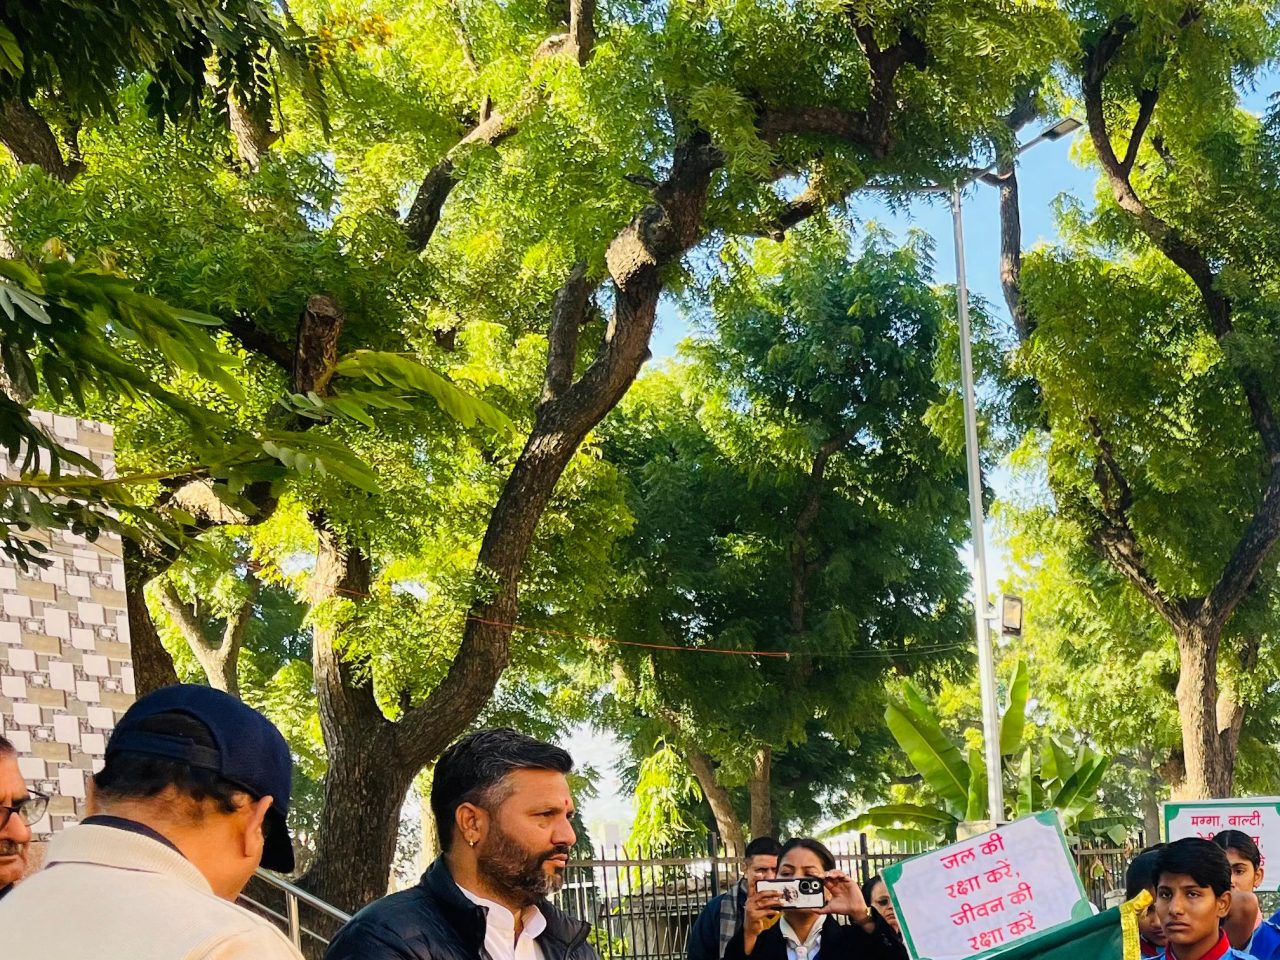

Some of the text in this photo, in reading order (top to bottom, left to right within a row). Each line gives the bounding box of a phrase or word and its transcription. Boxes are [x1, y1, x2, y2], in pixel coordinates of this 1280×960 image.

[1228, 810, 1264, 828] बाल्टी,
[940, 832, 1005, 870] जल की
[945, 858, 1021, 898] रक्षा करें,
[951, 882, 1034, 926] जीवन की
[968, 910, 1036, 951] रक्षा करें
